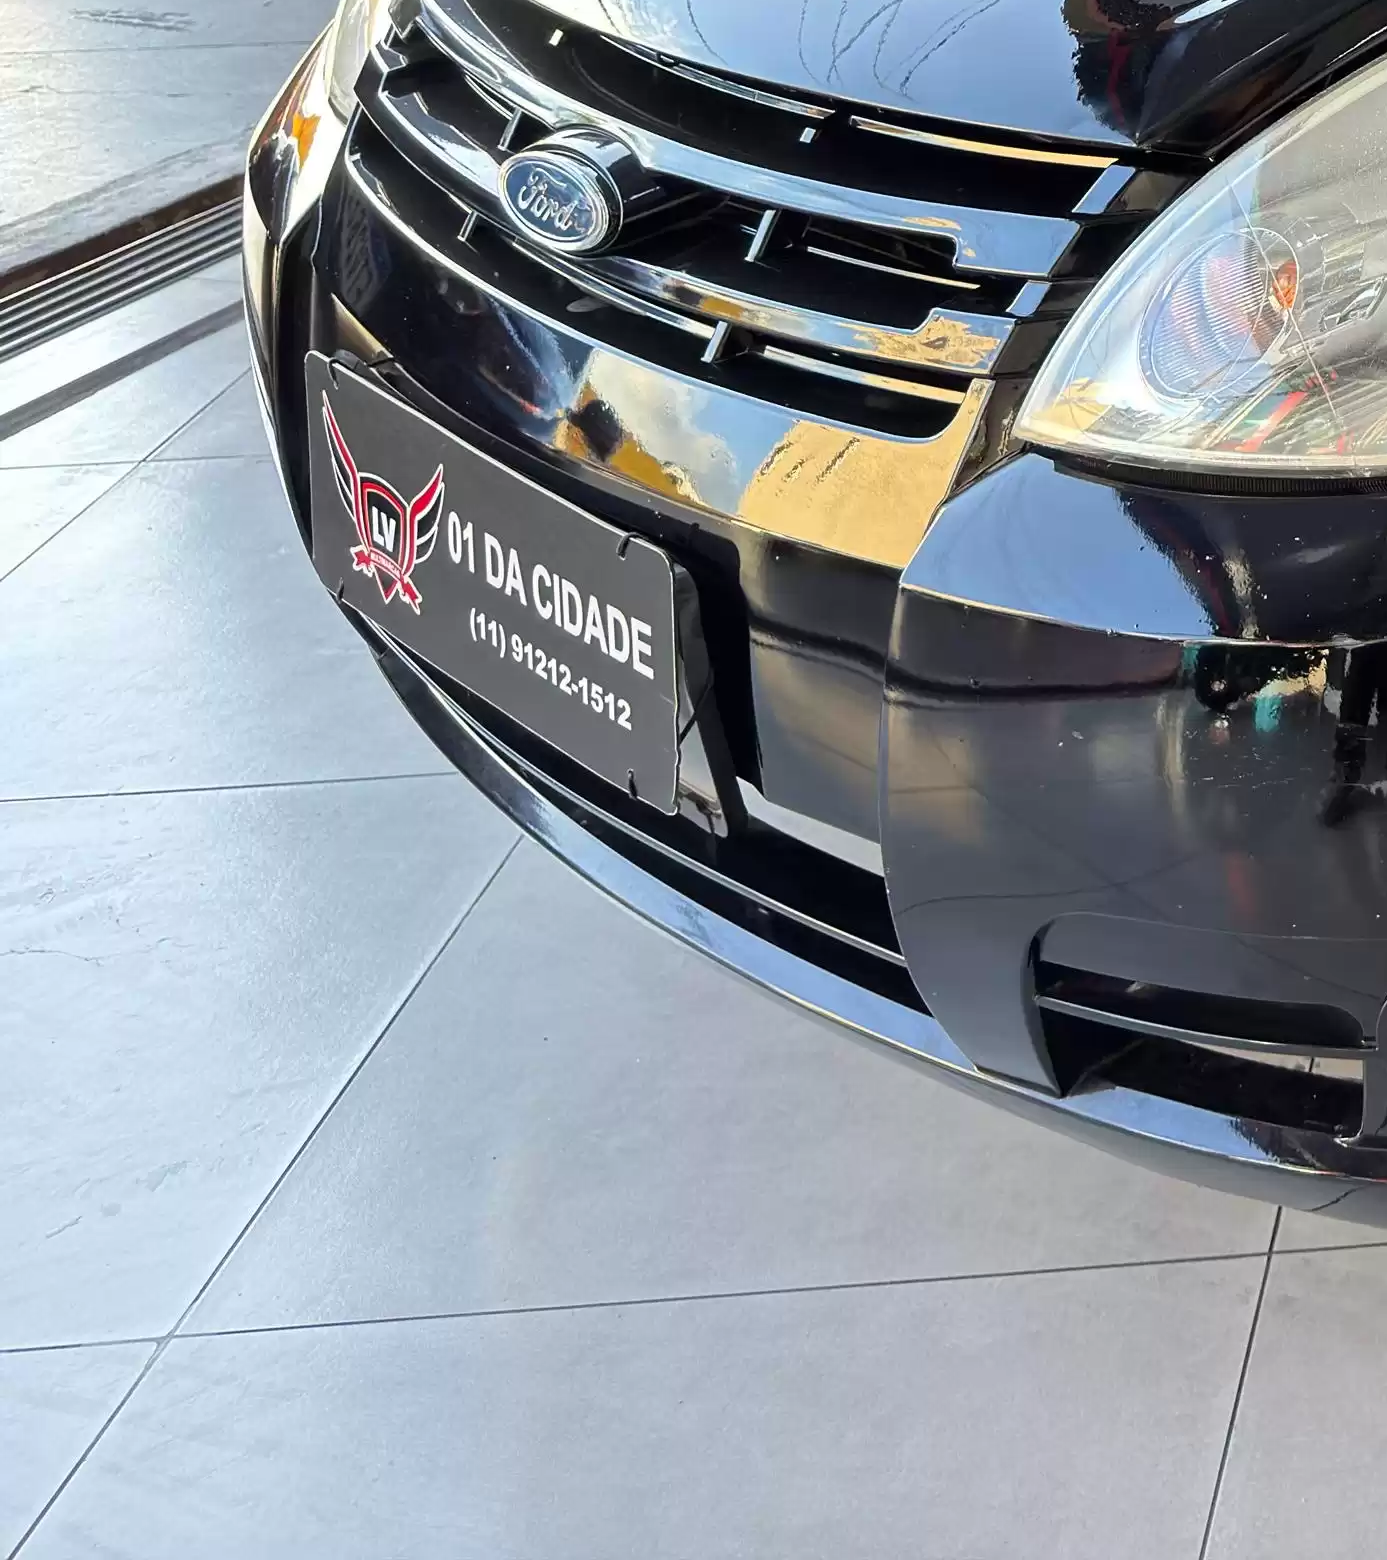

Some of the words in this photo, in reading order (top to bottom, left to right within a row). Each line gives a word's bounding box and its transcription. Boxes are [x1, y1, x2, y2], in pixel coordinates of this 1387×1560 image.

[517, 166, 586, 232] Ford
[371, 504, 397, 554] LV
[448, 511, 475, 574] 01
[484, 532, 527, 606] DA
[532, 564, 655, 680] CIDADE
[469, 607, 507, 659] (11)
[511, 633, 633, 731] 91212-1512
